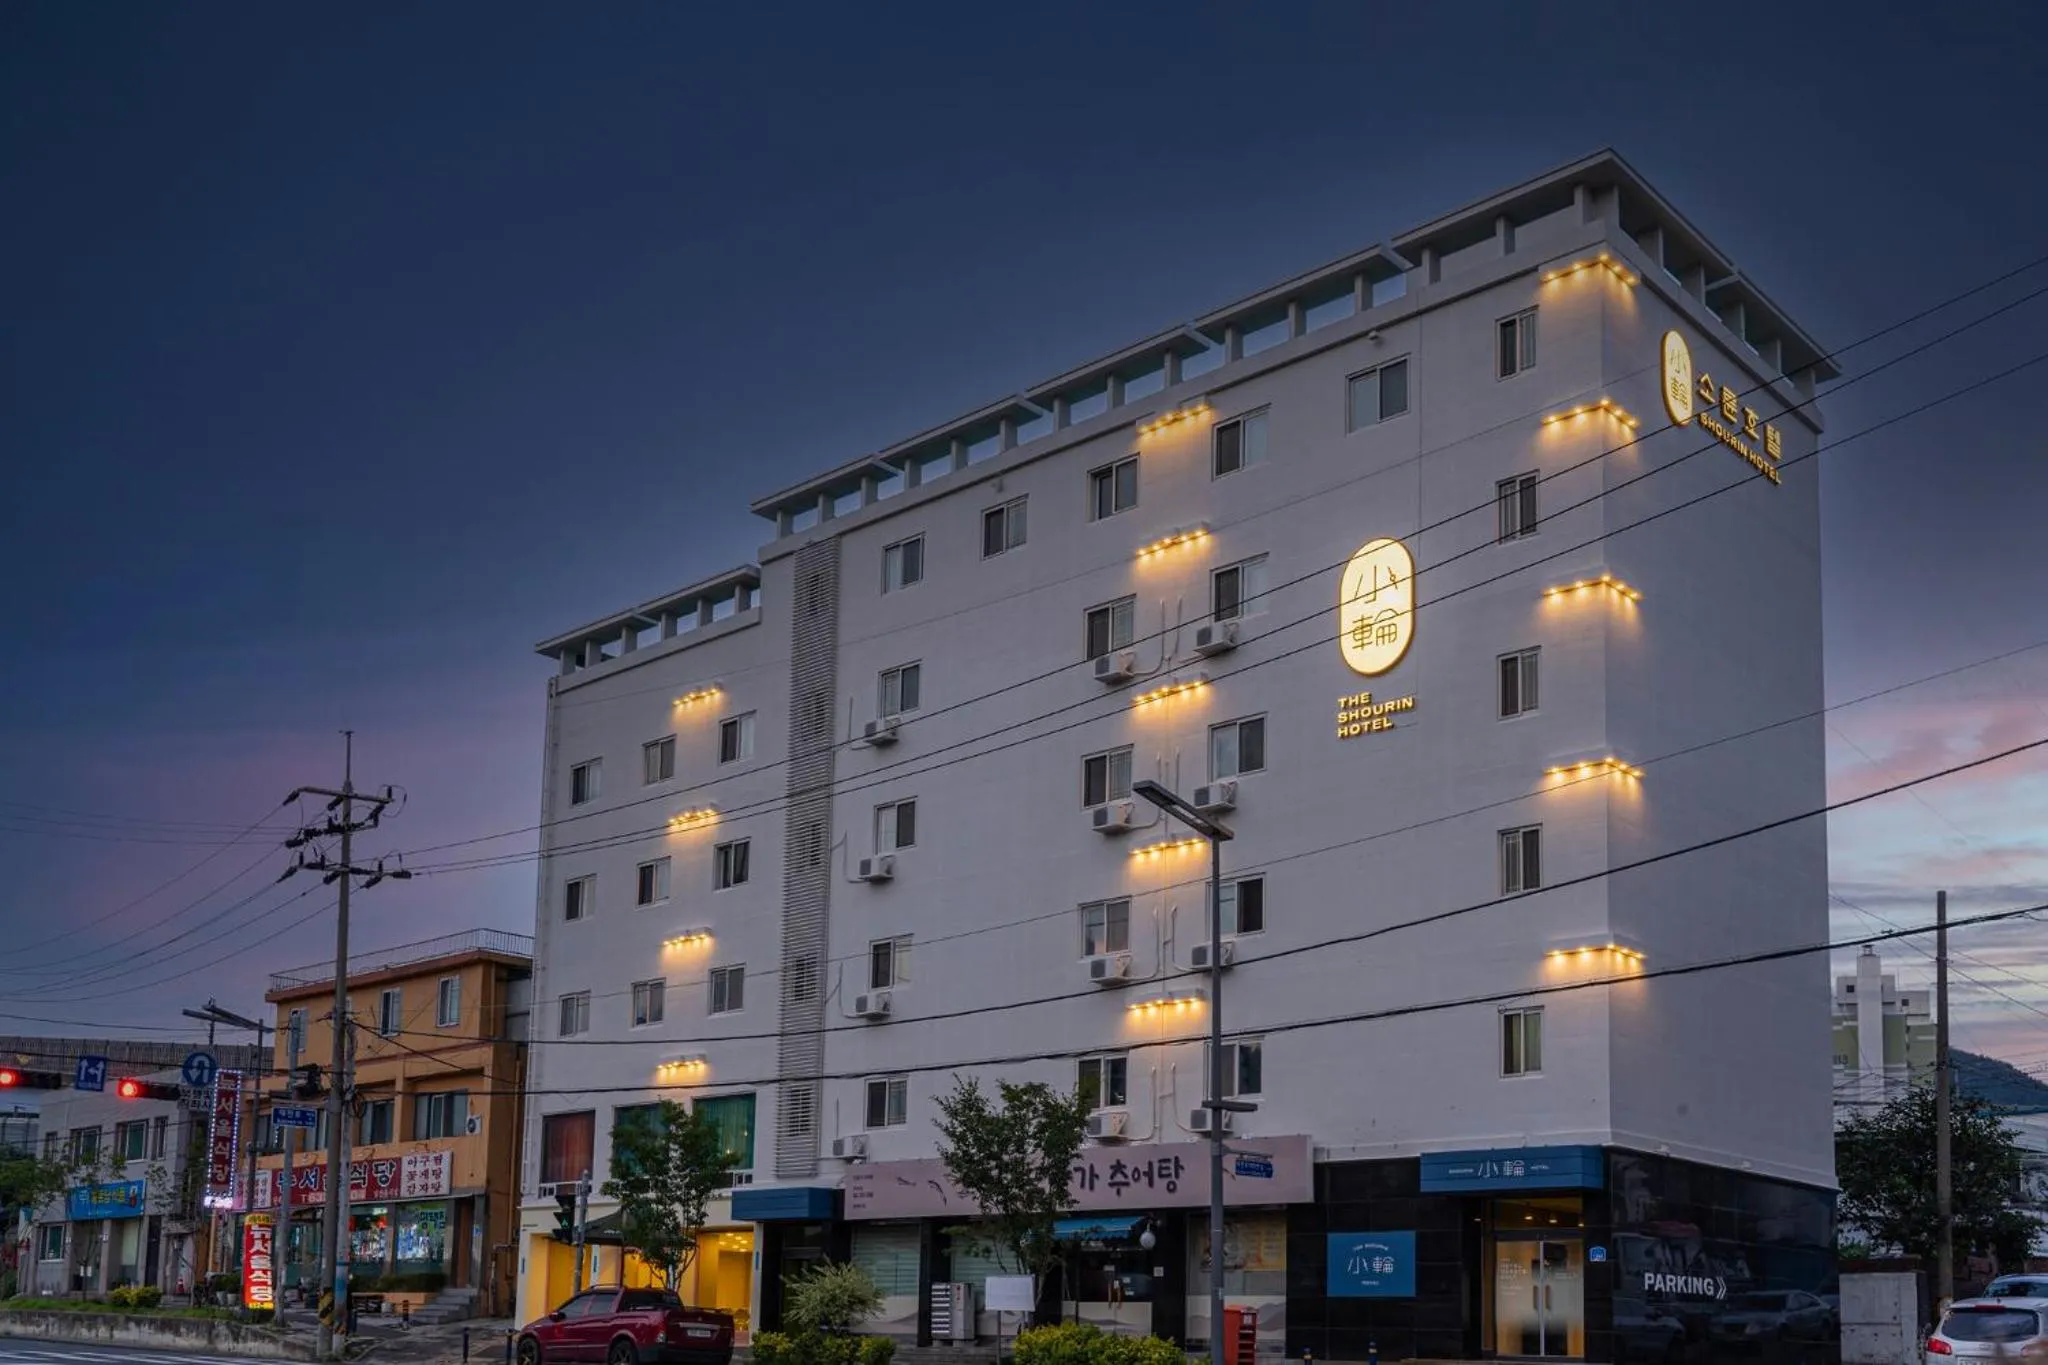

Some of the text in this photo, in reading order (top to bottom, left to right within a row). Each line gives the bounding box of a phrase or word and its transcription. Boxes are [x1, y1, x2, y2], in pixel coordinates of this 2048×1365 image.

[1697, 374, 1782, 461] 소륜호텔
[1698, 412, 1782, 485] SHOURIN HOTEL
[1337, 692, 1372, 709] THE
[1337, 697, 1414, 724] SHOURIN
[1337, 717, 1394, 739] HOTEL
[1108, 1156, 1185, 1197] 추어탕
[1644, 1271, 1715, 1297] PARKING
